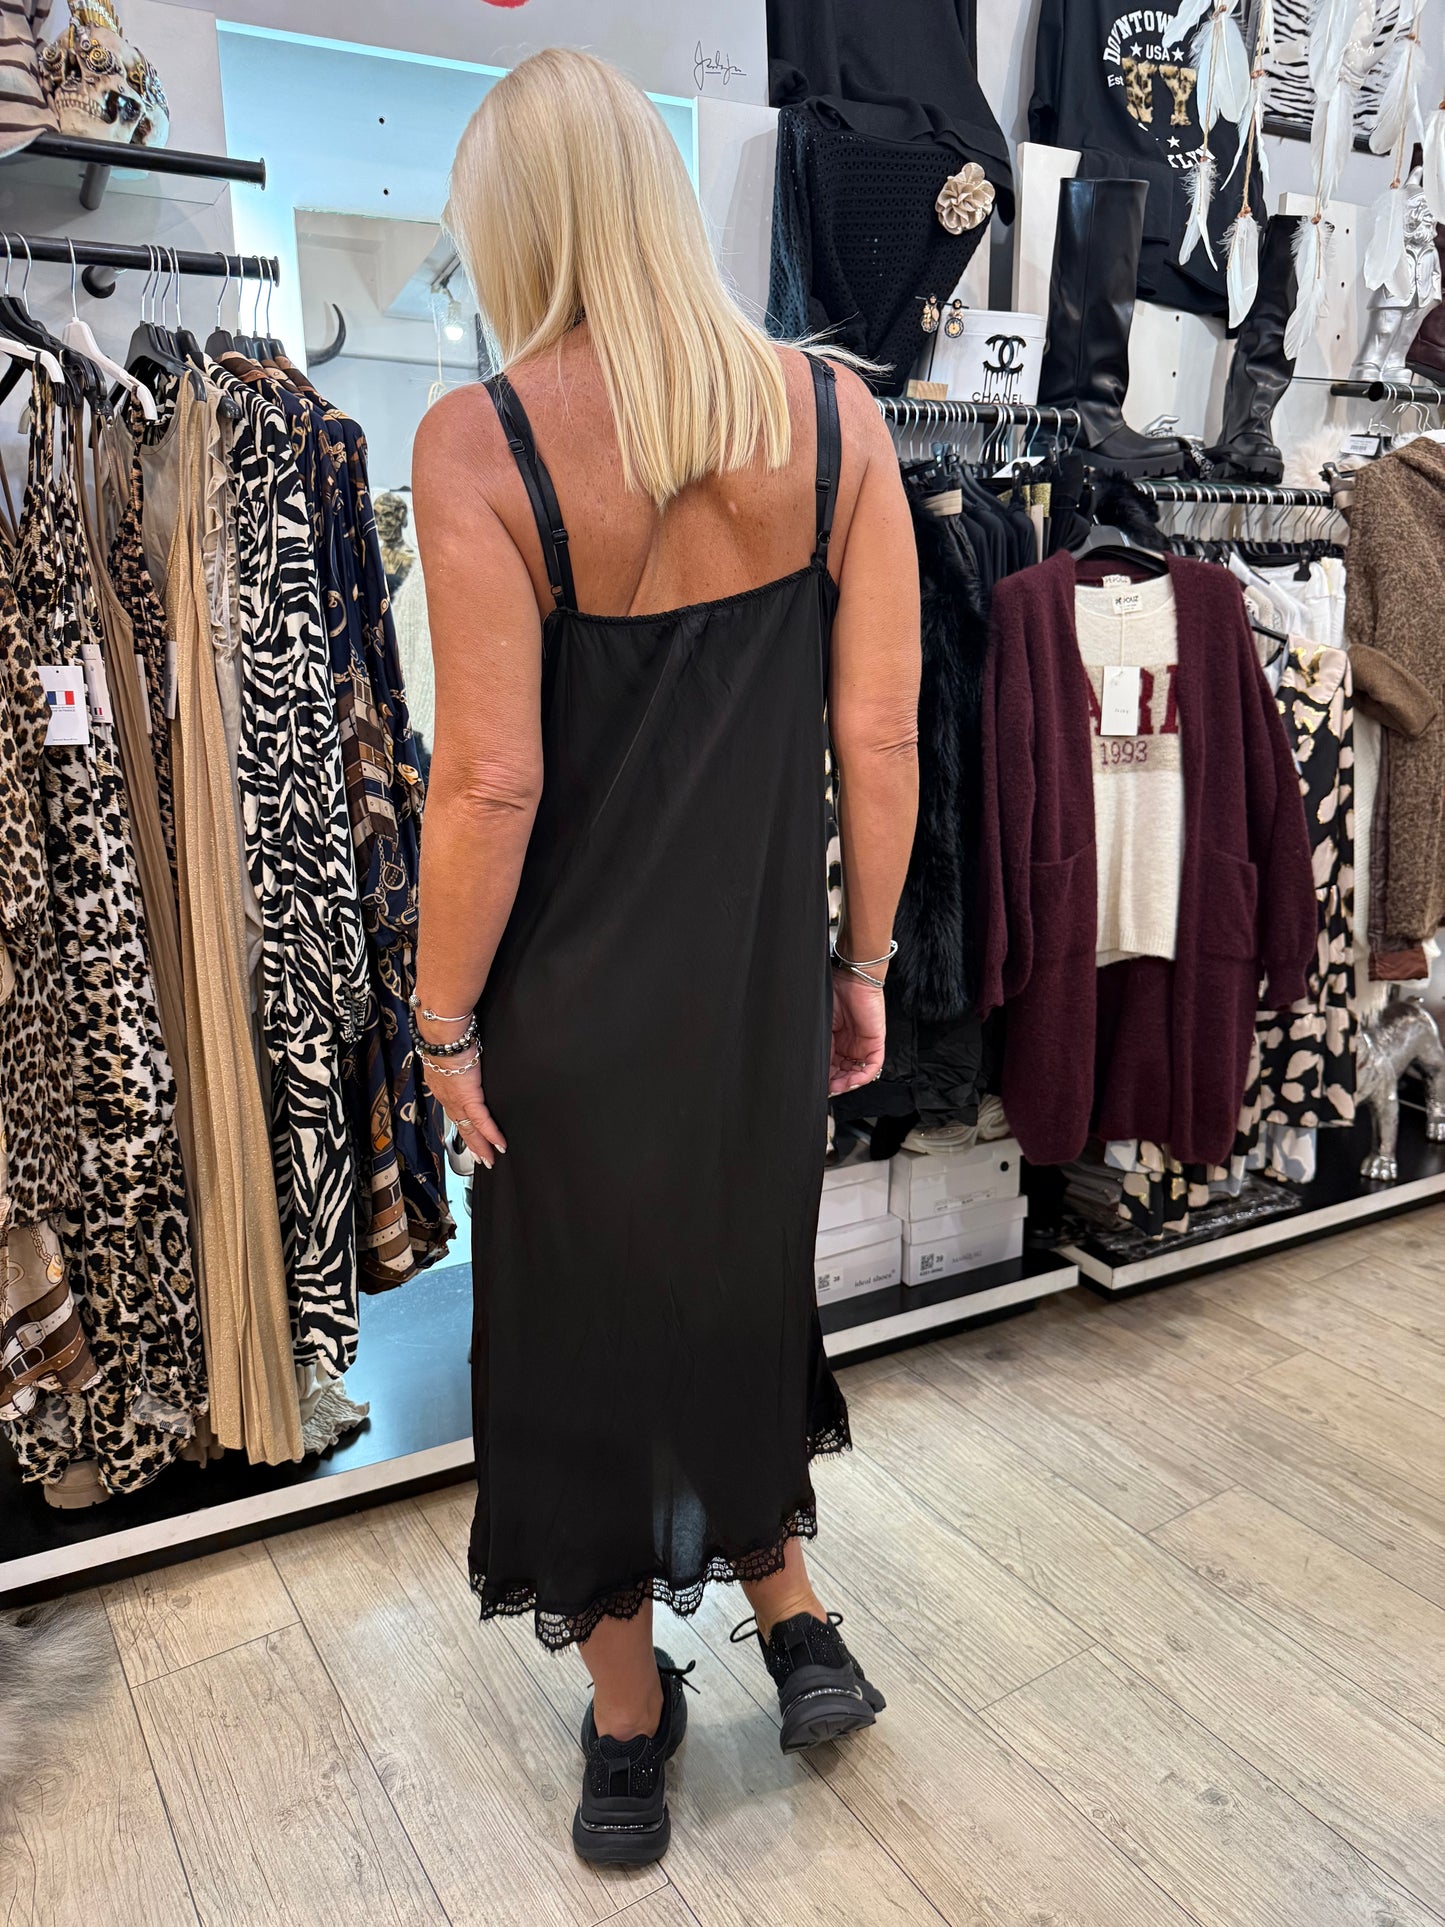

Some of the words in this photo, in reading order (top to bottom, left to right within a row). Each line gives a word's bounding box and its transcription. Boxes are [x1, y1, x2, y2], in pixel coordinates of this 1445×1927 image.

[1103, 10, 1175, 66] DOWNTOW
[1145, 44, 1170, 62] USA
[972, 391, 1025, 405] CHANEL
[1100, 741, 1148, 765] 1993
[854, 1276, 872, 1288] ideal
